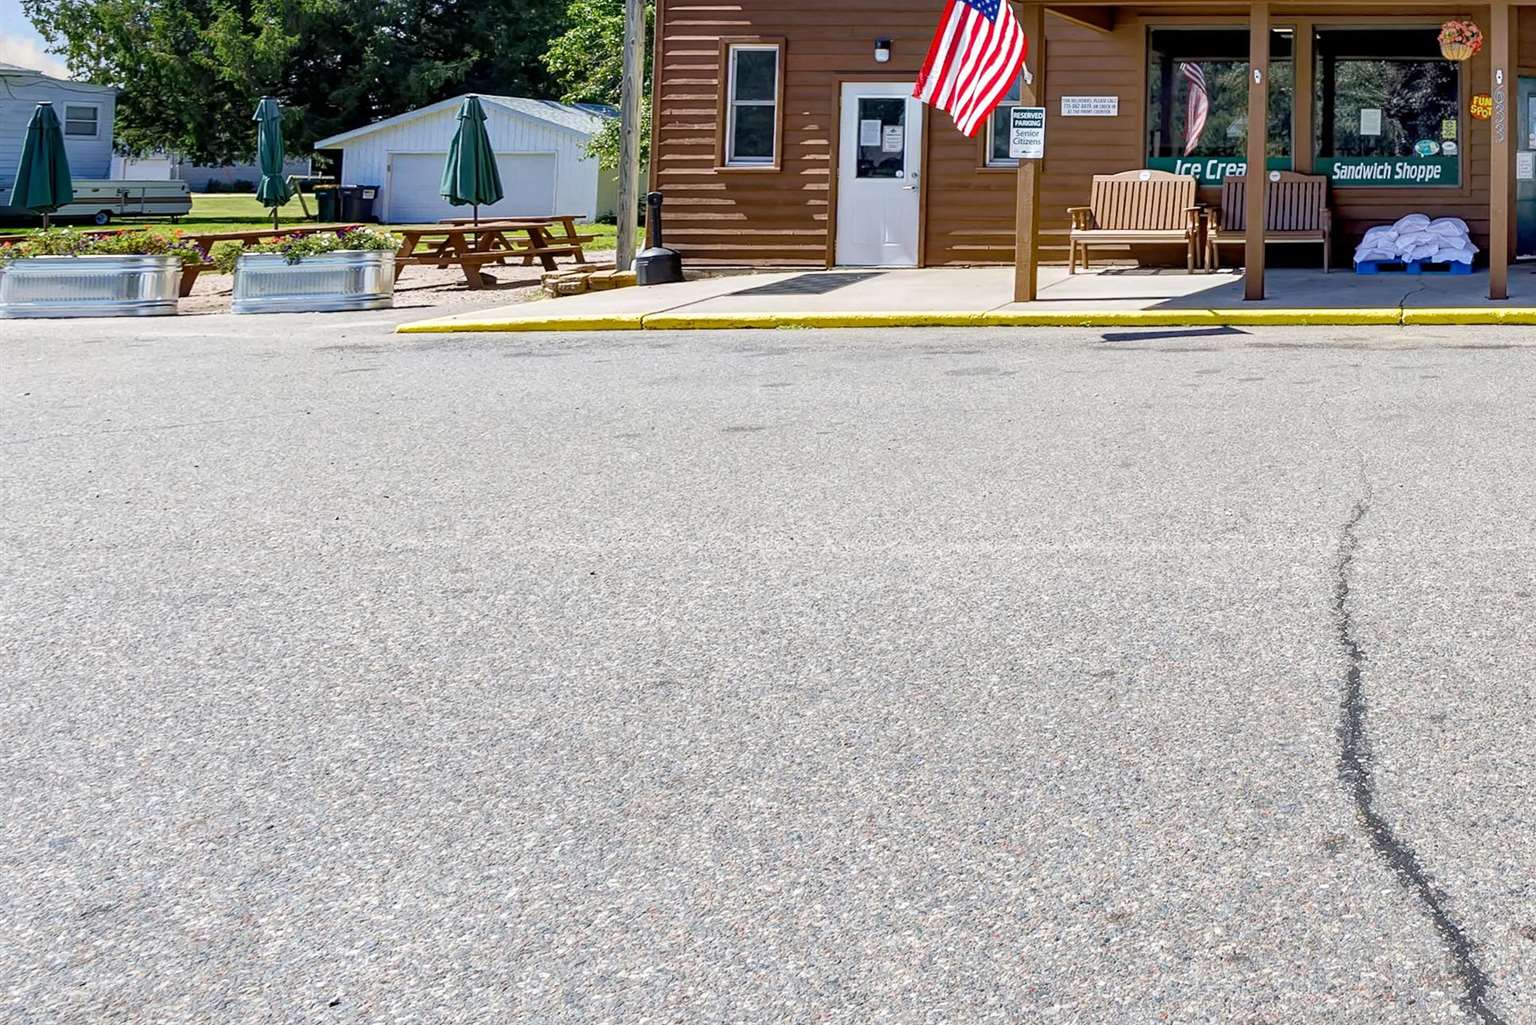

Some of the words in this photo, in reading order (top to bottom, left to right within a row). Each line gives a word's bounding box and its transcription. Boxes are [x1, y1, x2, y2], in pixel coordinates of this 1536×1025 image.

[1473, 95, 1493, 107] FUN
[1013, 111, 1043, 119] RESERVED
[1470, 104, 1493, 118] SPOT
[1014, 119, 1041, 127] PARKING
[1015, 128, 1040, 137] Senior
[1012, 137, 1042, 145] Citizens
[1175, 159, 1202, 179] Ice
[1205, 159, 1248, 180] Crea
[1332, 162, 1392, 180] Sandwich
[1394, 162, 1442, 182] Shoppe
